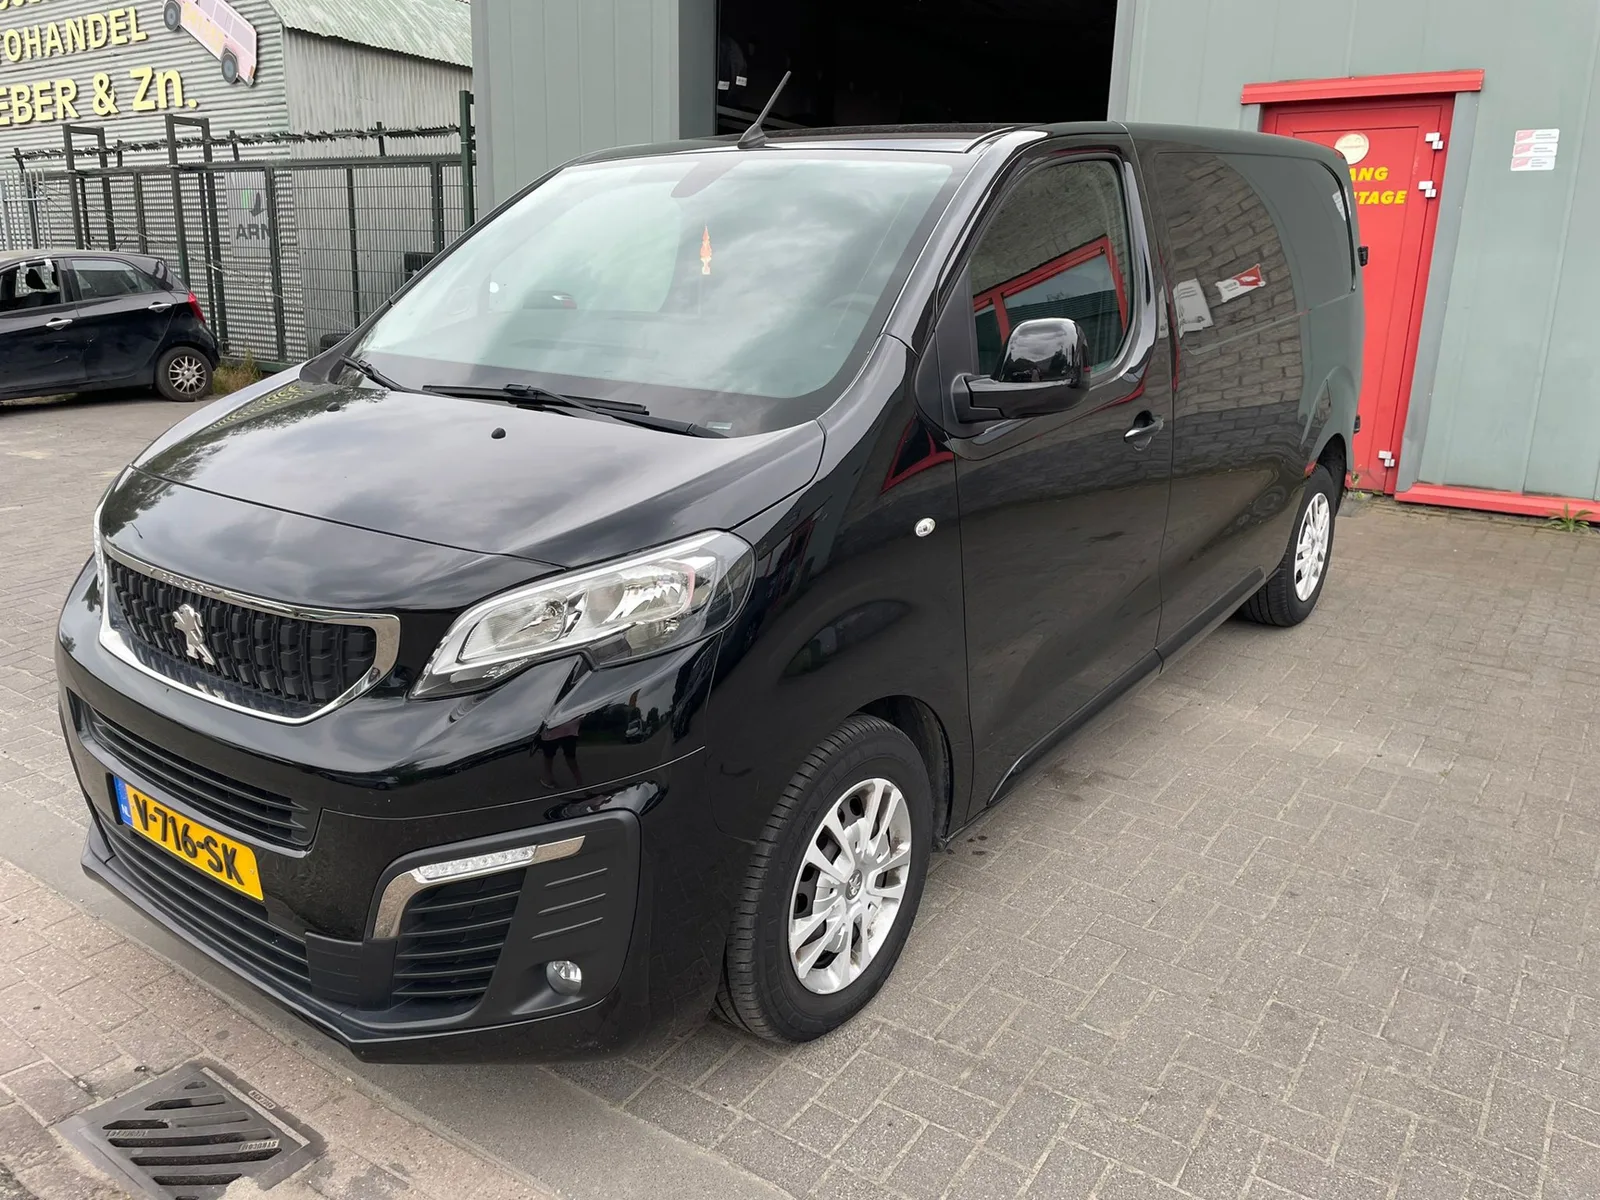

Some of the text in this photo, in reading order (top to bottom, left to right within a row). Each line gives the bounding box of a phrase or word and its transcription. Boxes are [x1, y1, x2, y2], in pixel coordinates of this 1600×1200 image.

[4, 6, 148, 63] OHANDEL
[92, 72, 119, 116] &
[130, 66, 198, 111] Zn.
[1353, 190, 1408, 205] TAGE
[121, 803, 131, 818] NL
[132, 793, 245, 886] V-716-SK
